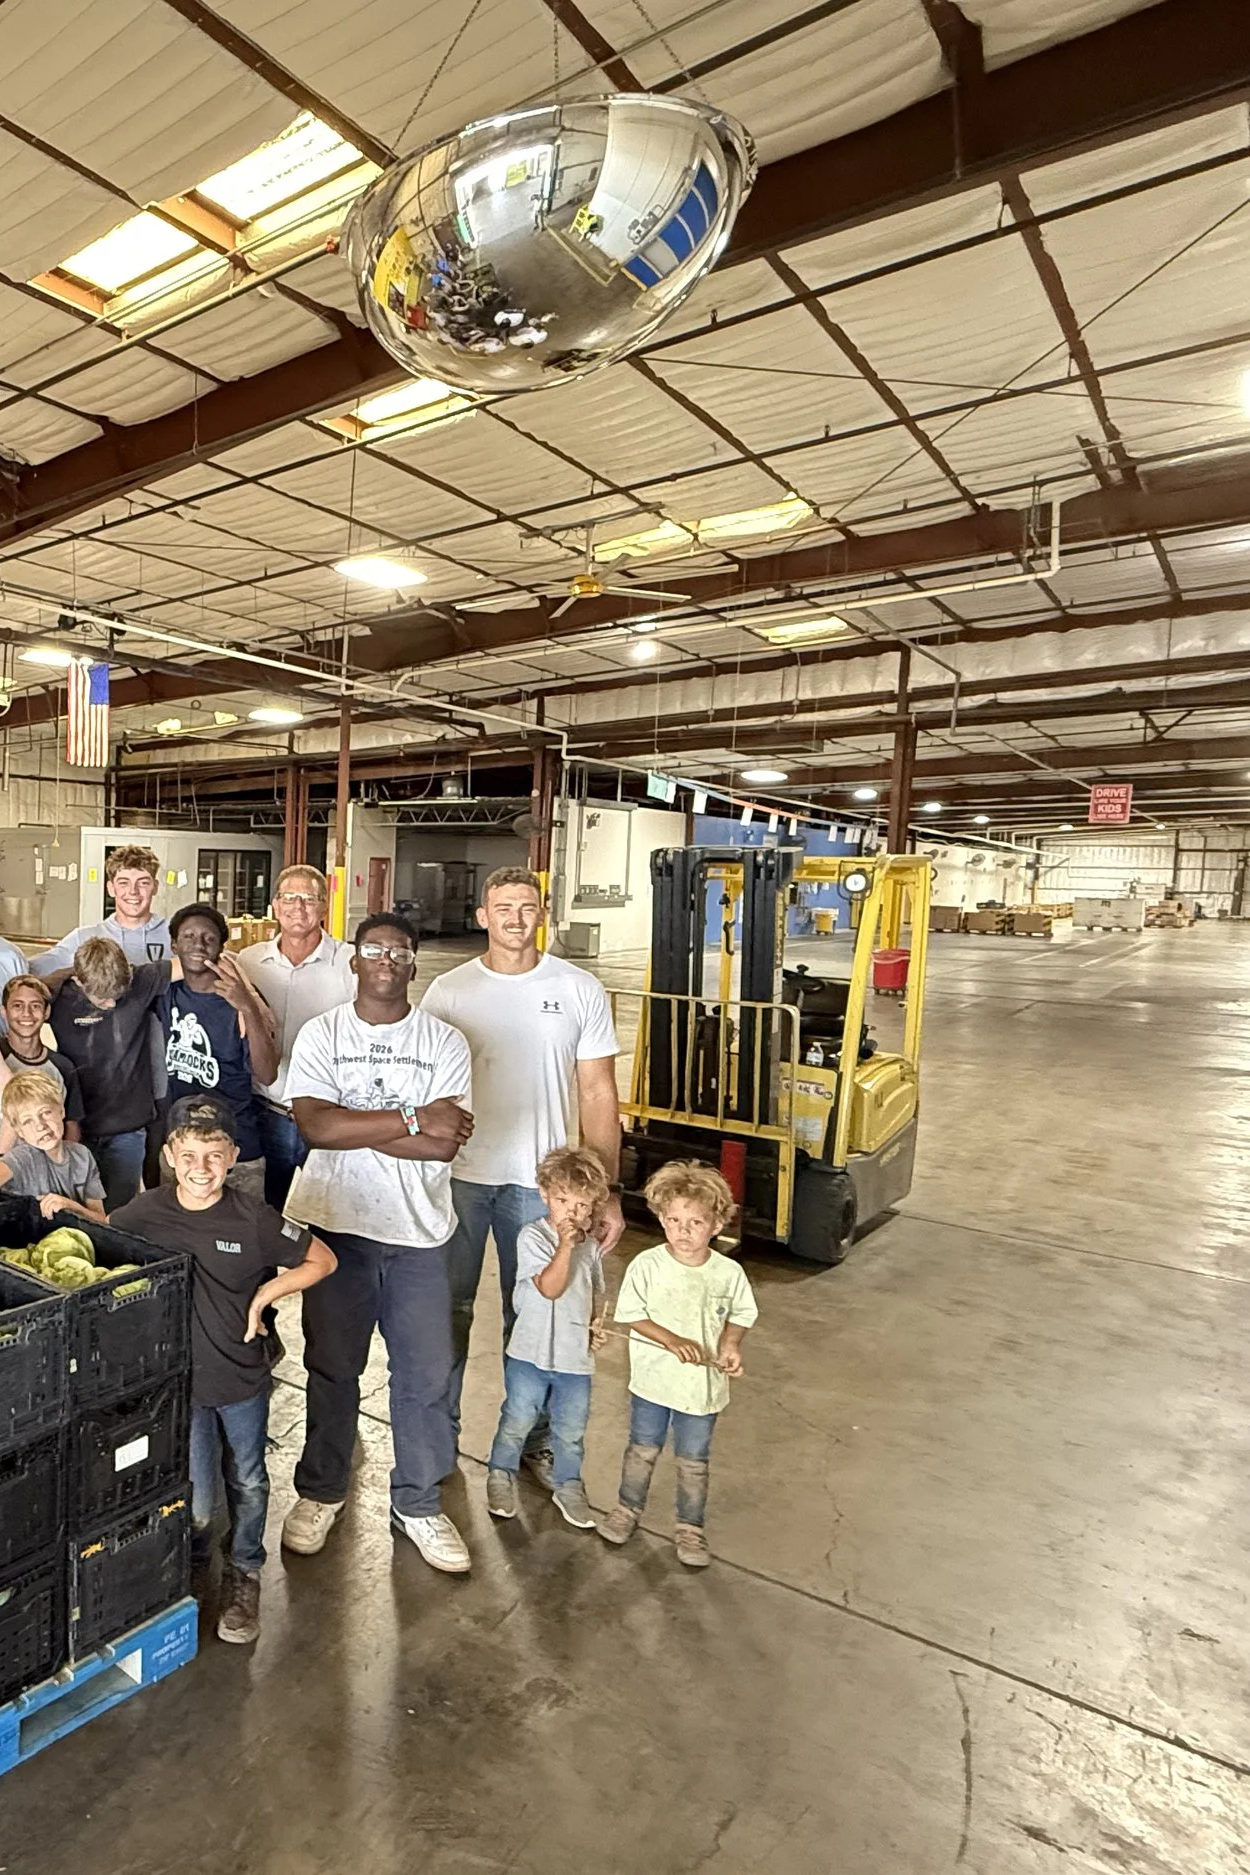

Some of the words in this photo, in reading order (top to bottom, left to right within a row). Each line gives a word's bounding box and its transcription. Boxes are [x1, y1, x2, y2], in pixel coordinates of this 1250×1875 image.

[1096, 788, 1127, 797] DRIVE
[1097, 804, 1122, 813] KIDS
[370, 1043, 393, 1054] 2026
[368, 1054, 392, 1066] Space
[393, 1055, 435, 1073] Settlemen
[215, 1239, 242, 1254] VALOR
